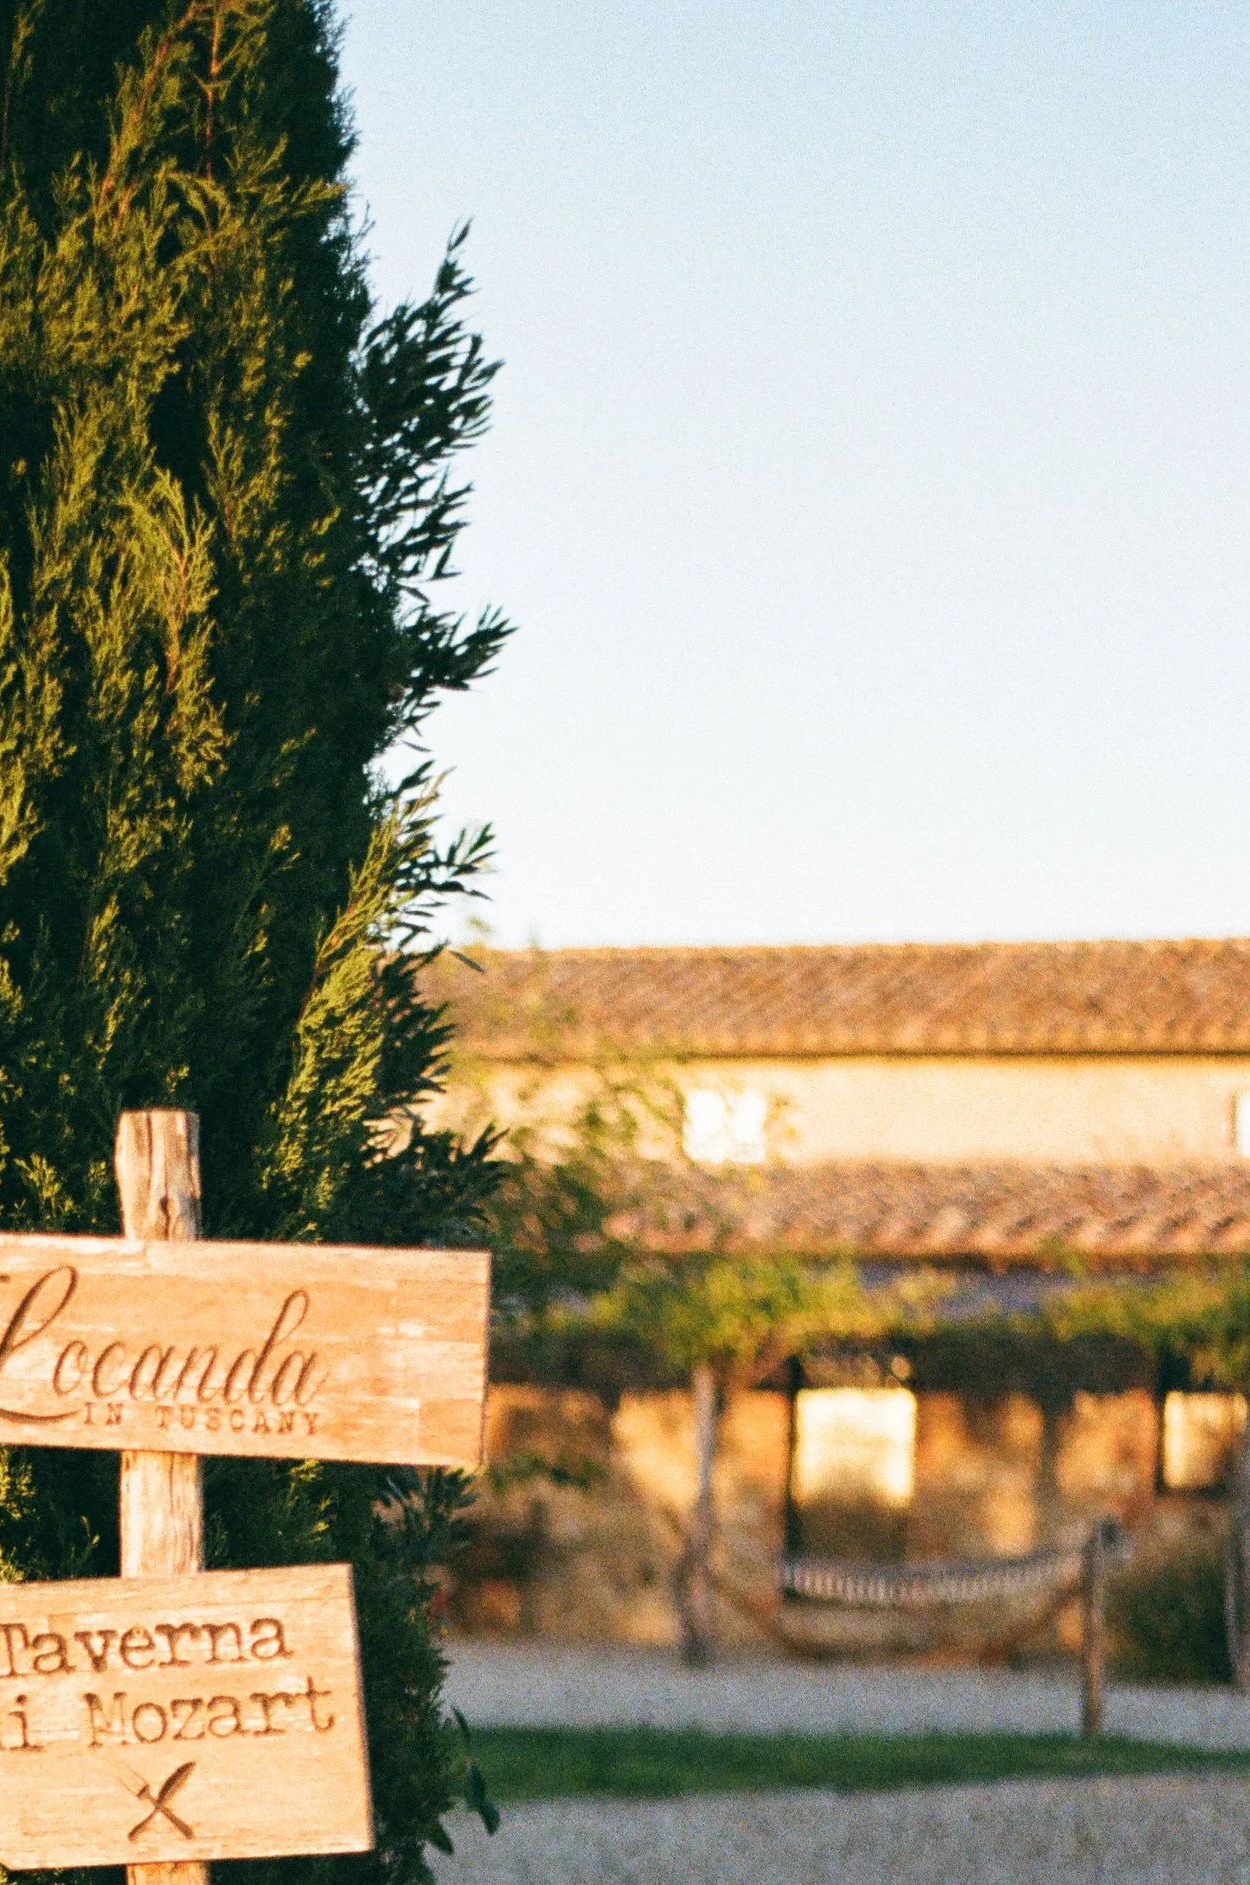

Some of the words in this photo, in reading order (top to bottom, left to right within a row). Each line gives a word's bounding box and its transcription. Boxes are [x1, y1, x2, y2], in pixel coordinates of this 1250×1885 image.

[82, 1401, 126, 1427] IN
[156, 1405, 321, 1437] TUSCANY
[83, 1675, 336, 1748] Mozart
